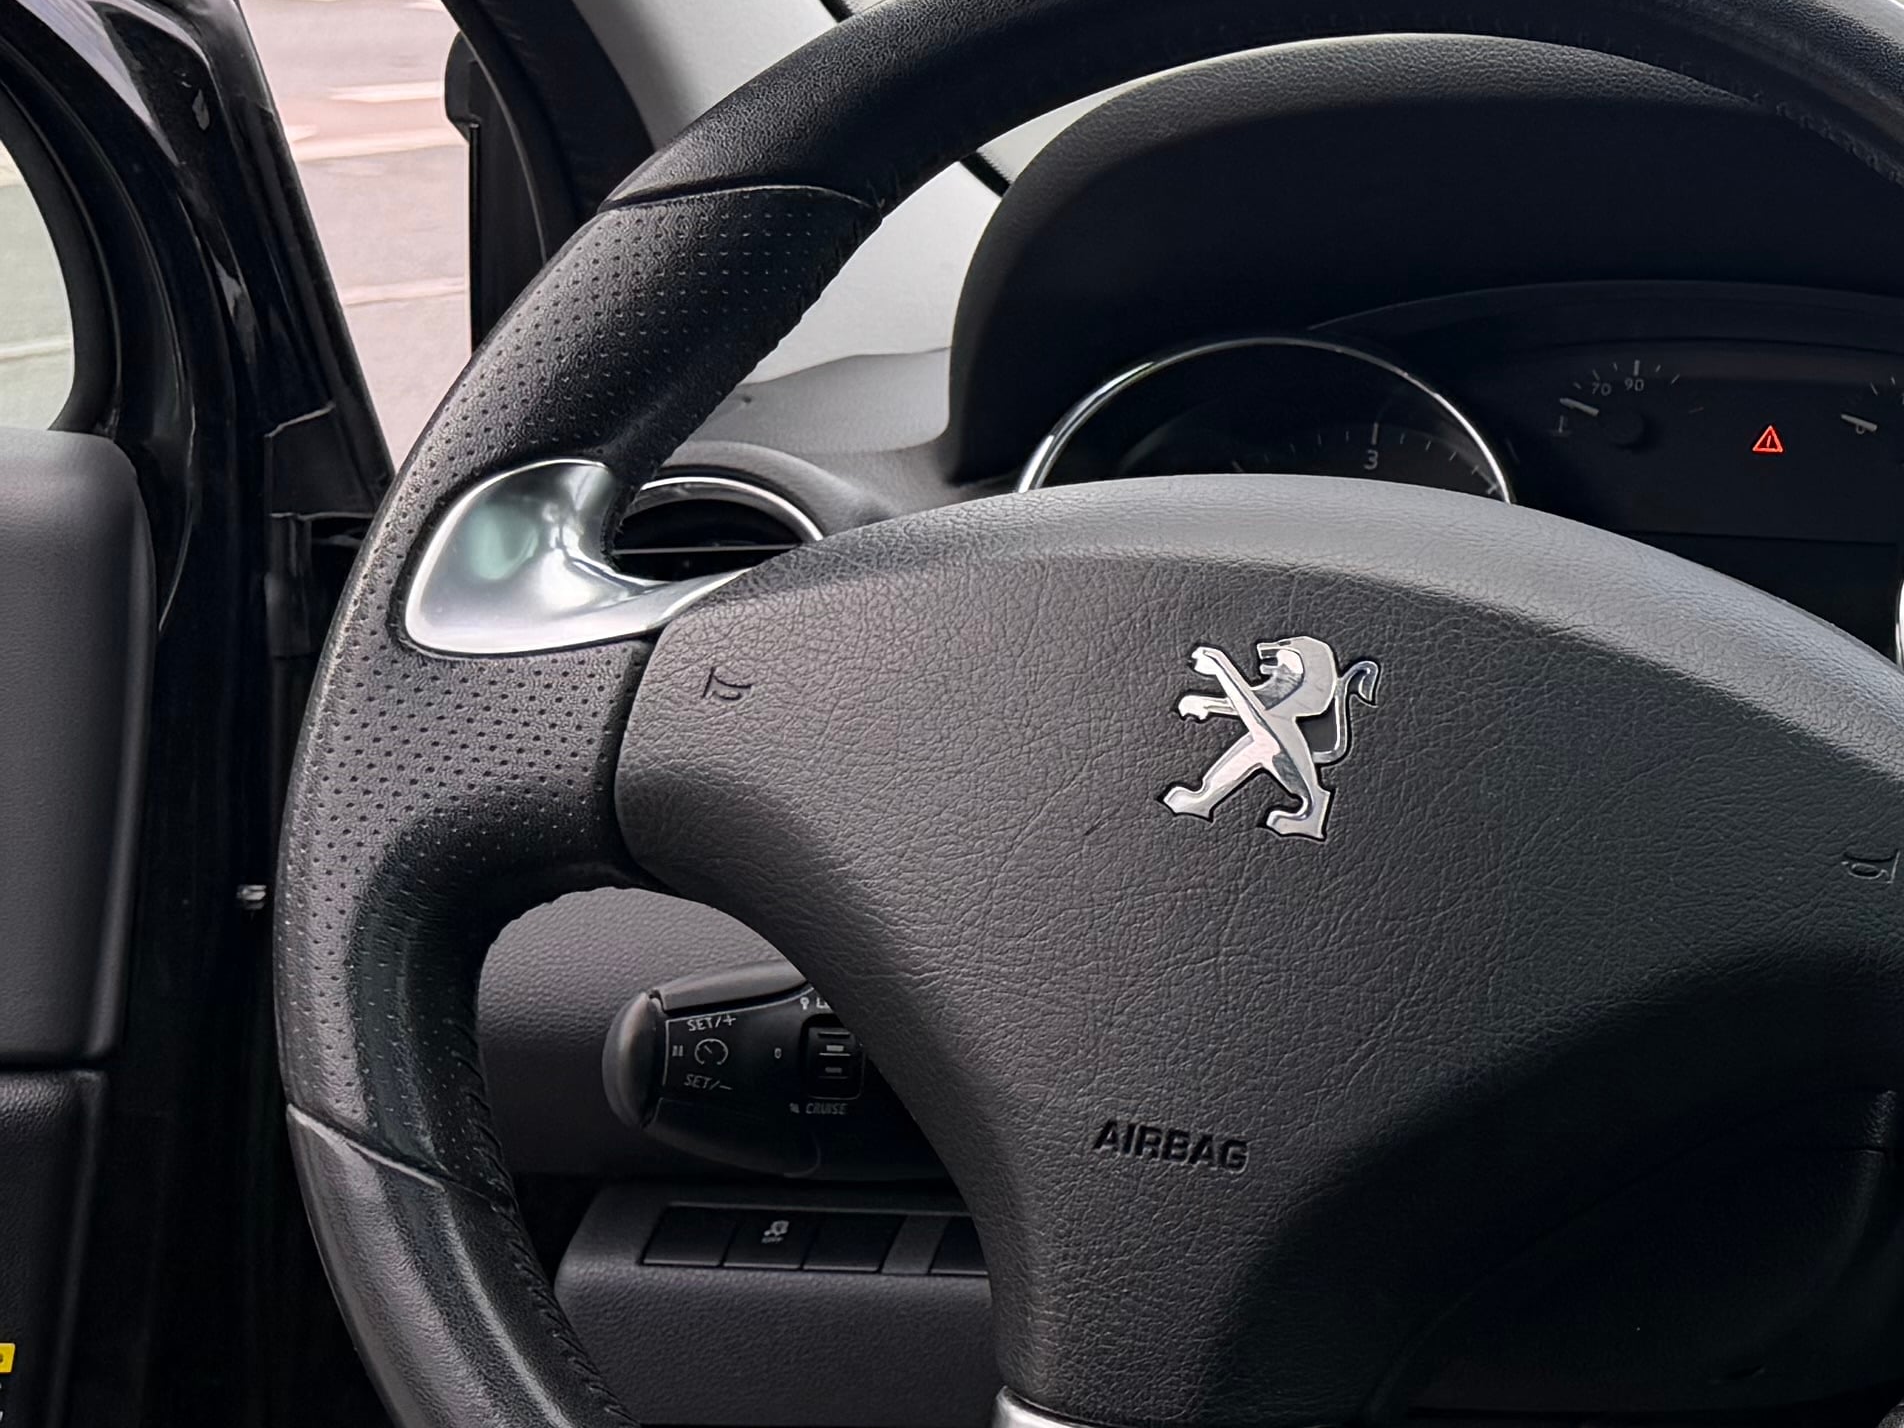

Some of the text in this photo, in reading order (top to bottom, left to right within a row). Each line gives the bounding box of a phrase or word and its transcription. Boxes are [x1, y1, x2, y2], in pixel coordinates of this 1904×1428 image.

[1591, 382, 1612, 397] 70
[1624, 378, 1645, 392] 90
[1363, 449, 1379, 470] 3
[1093, 1118, 1249, 1174] AIRBAG
